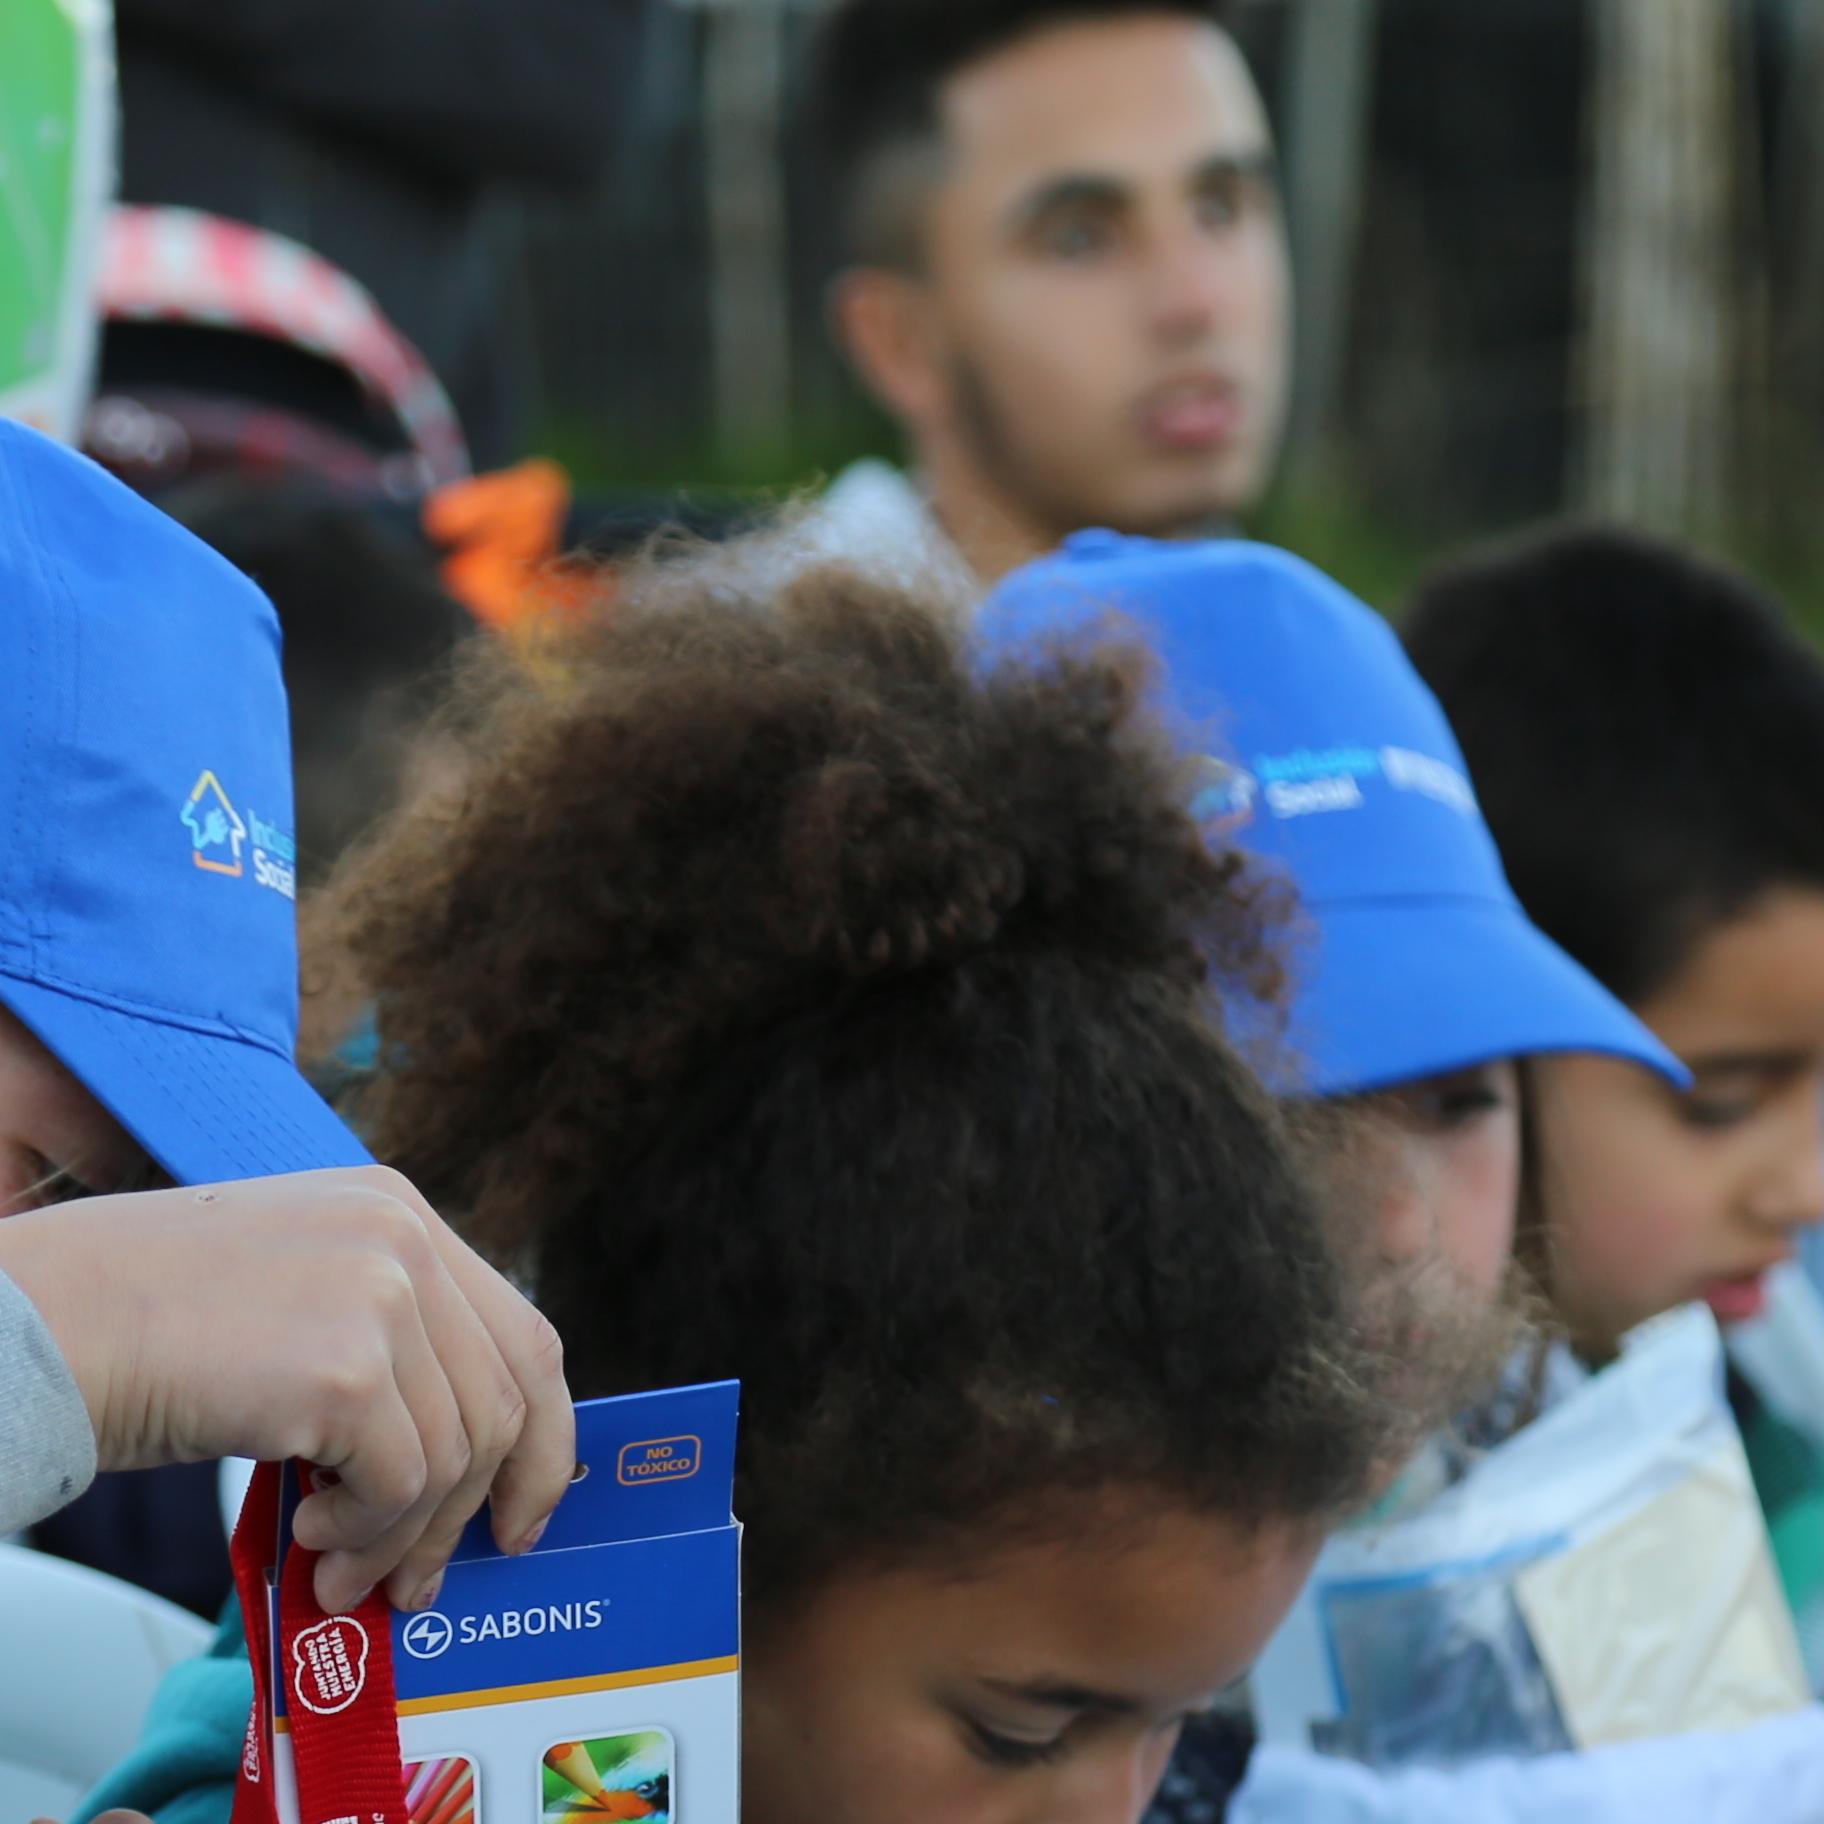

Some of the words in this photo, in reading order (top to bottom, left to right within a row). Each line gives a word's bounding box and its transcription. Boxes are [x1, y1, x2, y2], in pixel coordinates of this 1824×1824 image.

[647, 1446, 672, 1459] NO
[460, 1600, 602, 1644] SABONIS
[316, 1633, 344, 1698] NUESTRA
